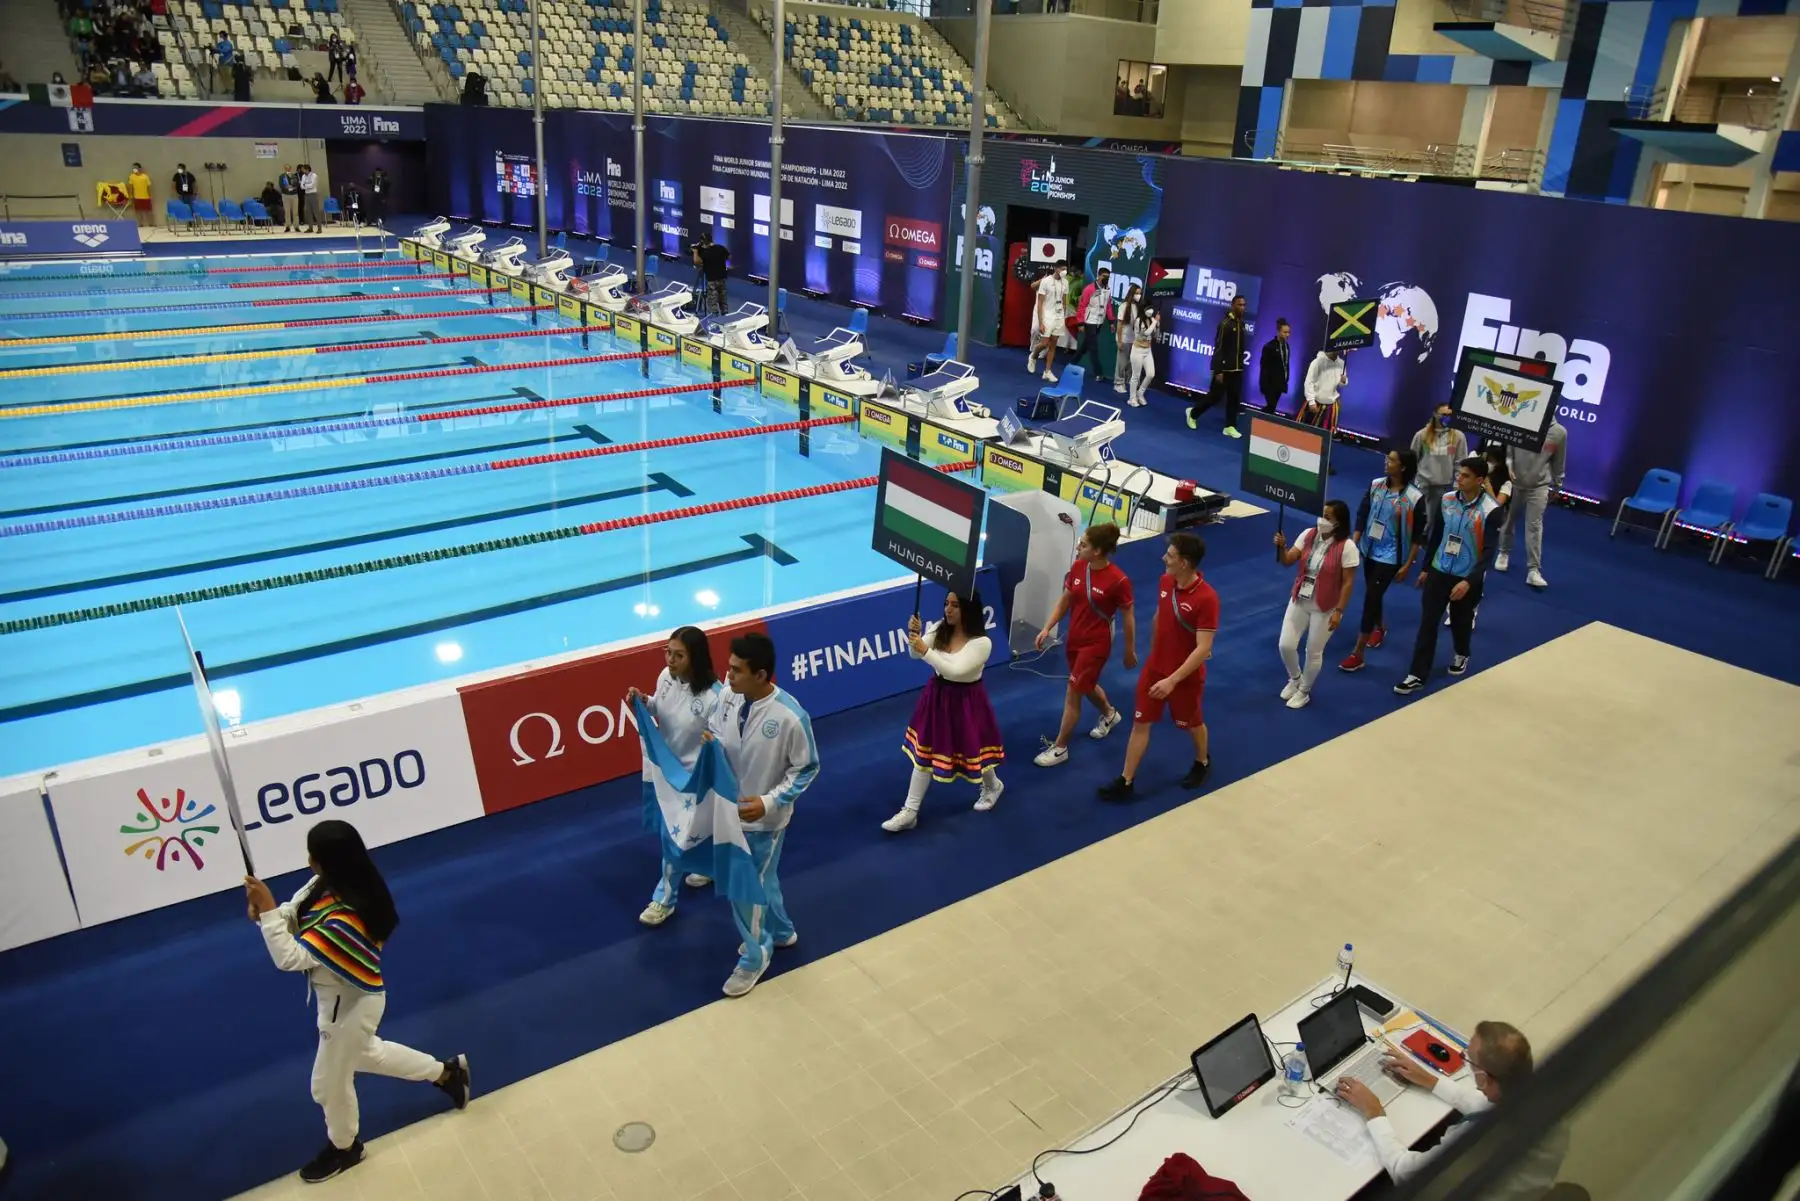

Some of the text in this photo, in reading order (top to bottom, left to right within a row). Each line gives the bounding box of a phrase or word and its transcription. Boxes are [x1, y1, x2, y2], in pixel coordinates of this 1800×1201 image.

[341, 116, 367, 124] LIMA
[373, 116, 400, 132] Fina
[344, 125, 366, 134] 2022
[781, 163, 816, 174] HAMPIONSHIPS
[820, 168, 832, 176] LIMA
[833, 170, 845, 178] 2022
[750, 170, 770, 179] MUNDIAL
[822, 179, 834, 188] LIMA
[835, 181, 848, 190] 2022
[577, 184, 602, 198] 2022
[72, 224, 107, 234] arena
[901, 228, 936, 245] OMEGA
[1196, 268, 1237, 302] Fina
[1172, 308, 1202, 320] FINA.ORG
[751, 334, 757, 342] 3
[1334, 339, 1364, 348] JAMAICA
[1453, 292, 1611, 406] Fina
[844, 363, 850, 373] 2
[770, 373, 786, 385] OMEGA
[959, 402, 964, 411] 1
[1554, 405, 1597, 423] ORLD
[870, 409, 890, 424] OMEGA
[1456, 415, 1478, 424] VIRGIN
[1481, 422, 1511, 434] ISLANDS
[1468, 425, 1522, 444] UNITED STATES
[953, 439, 964, 452] Fina
[1102, 446, 1109, 459] 0
[998, 456, 1023, 471] OMEGA
[1265, 484, 1295, 501] INDIA
[889, 540, 953, 580] HUNGARY
